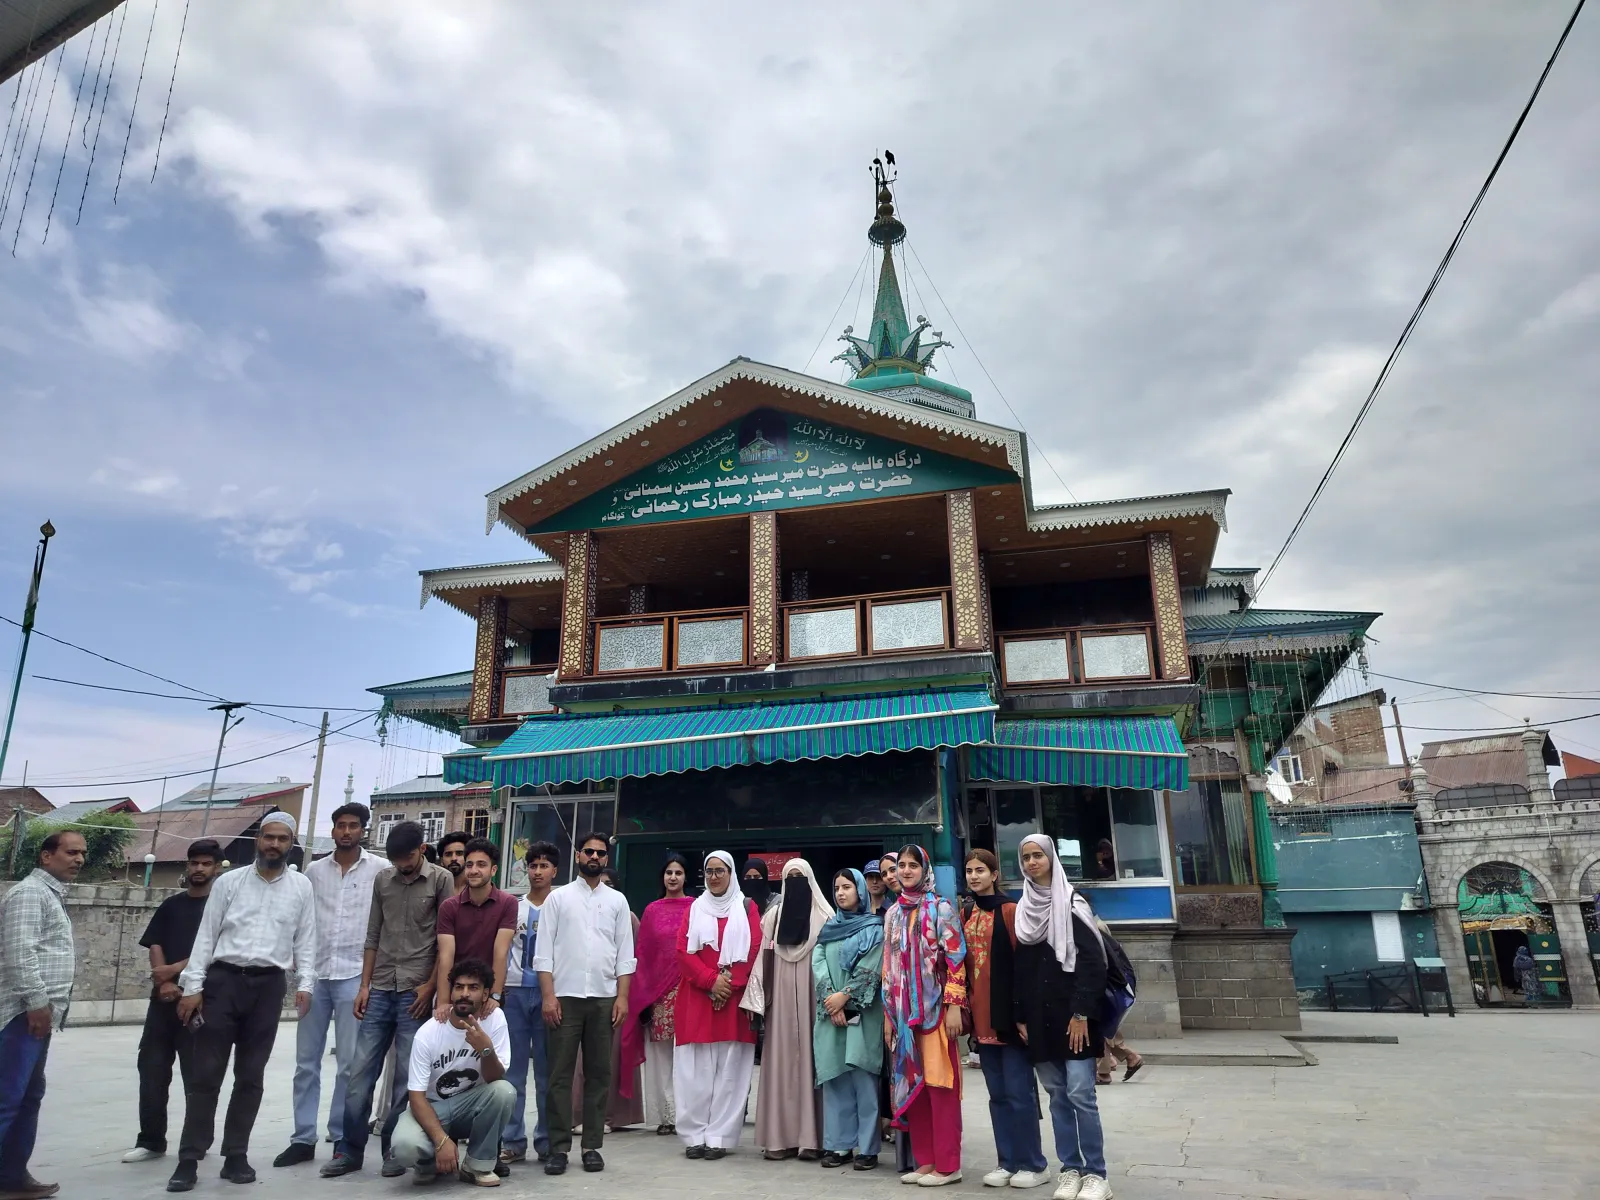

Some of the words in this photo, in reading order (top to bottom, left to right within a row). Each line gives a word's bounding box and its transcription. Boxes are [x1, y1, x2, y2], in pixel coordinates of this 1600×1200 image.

[751, 471, 779, 486] سید
[779, 467, 805, 483] میر
[806, 460, 849, 479] حضرت
[674, 477, 712, 496] حسین
[714, 472, 749, 488] محمد
[824, 479, 856, 498] میر
[859, 472, 913, 492] حضرت
[623, 481, 673, 500] سمنانی
[743, 487, 785, 506] حیدر
[788, 484, 823, 500] سید
[631, 495, 689, 519] رحمانی
[692, 491, 742, 510] مبارک
